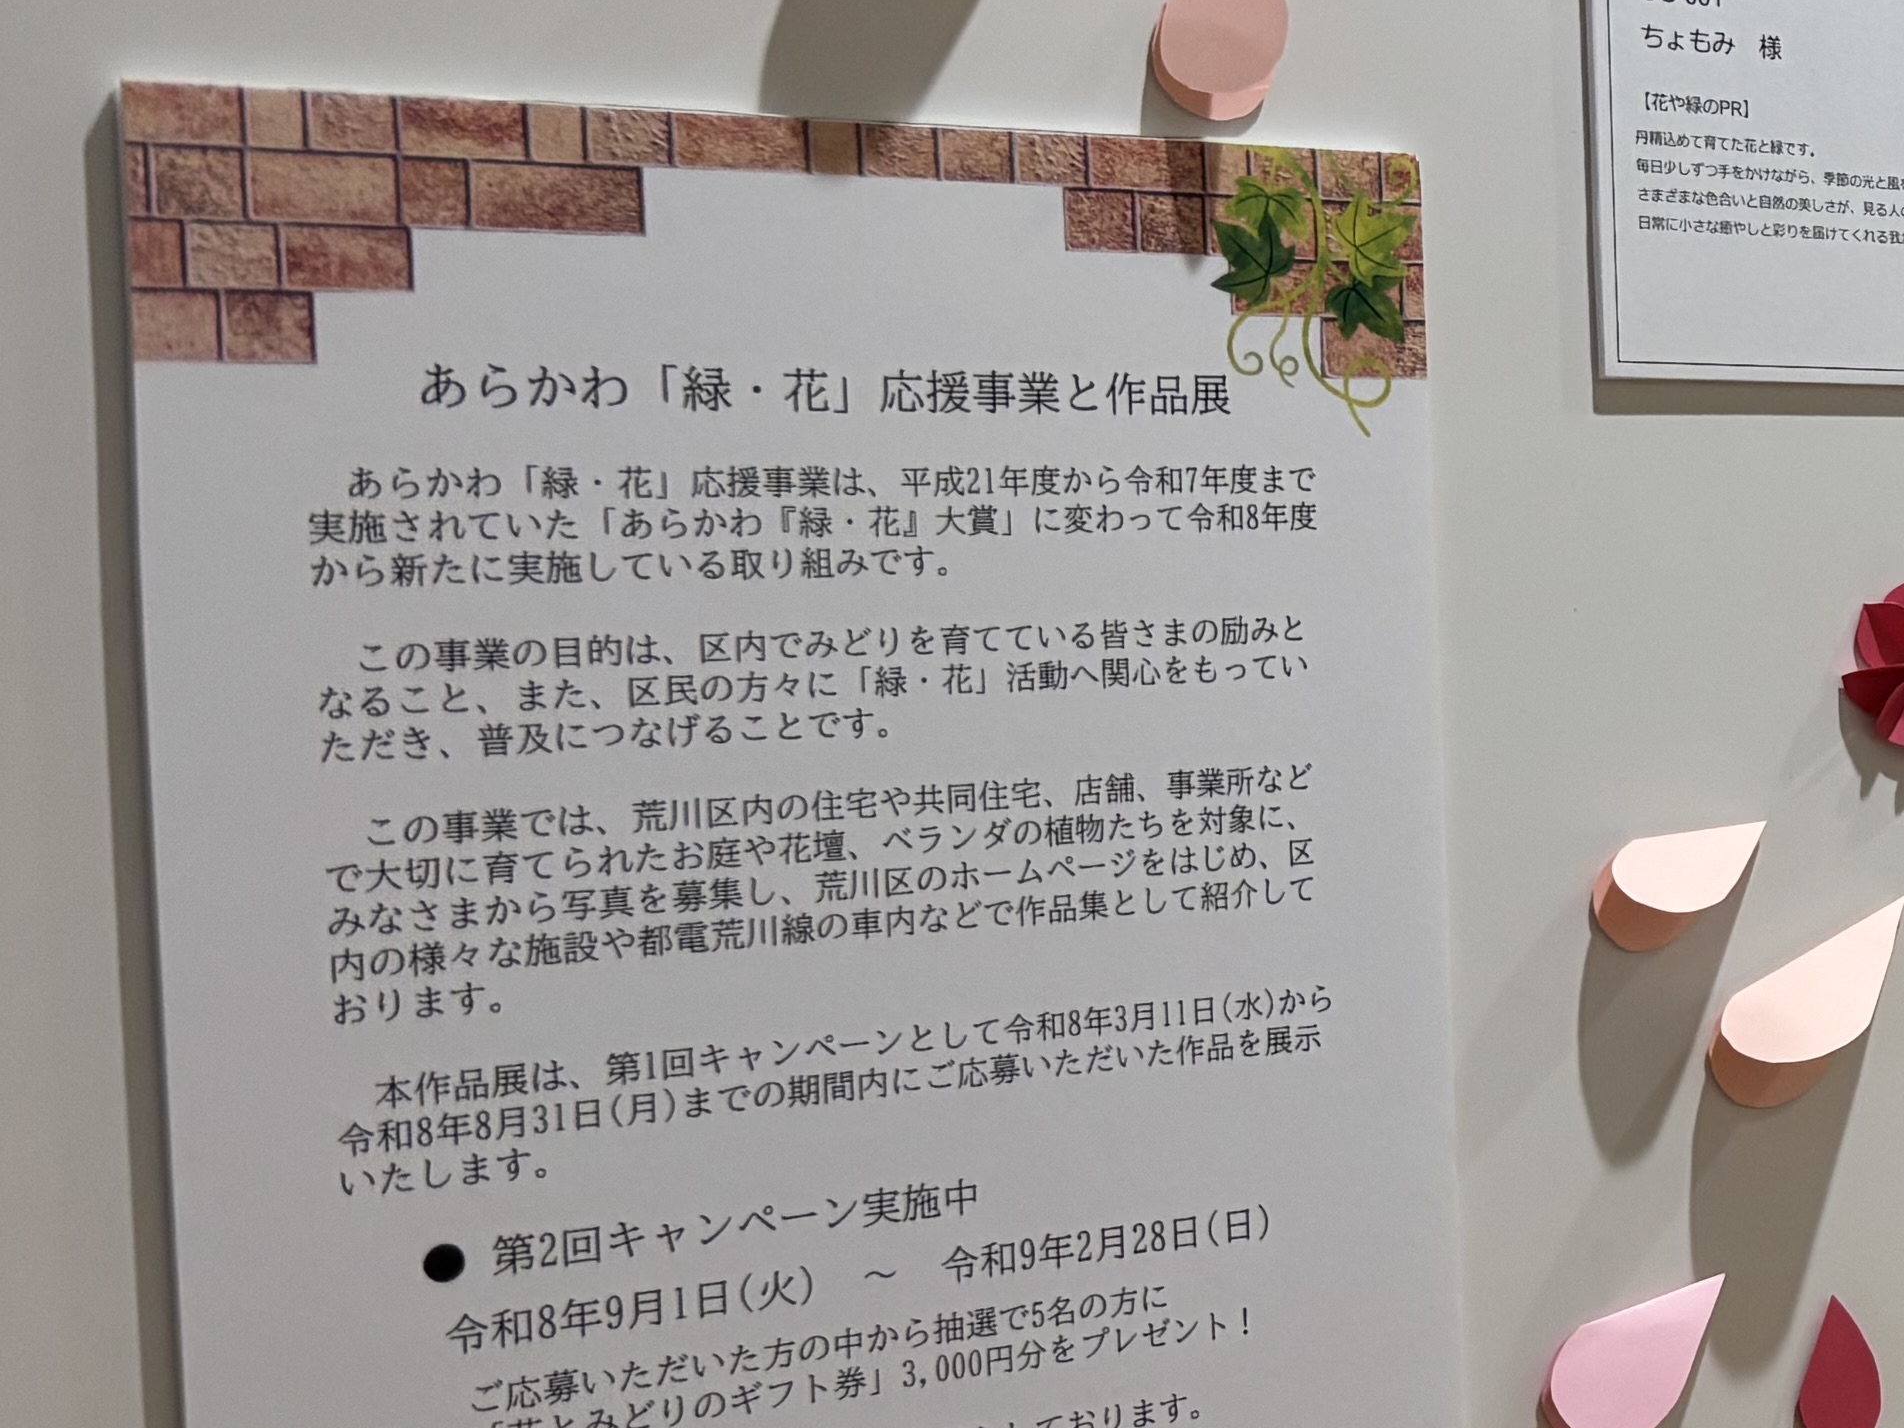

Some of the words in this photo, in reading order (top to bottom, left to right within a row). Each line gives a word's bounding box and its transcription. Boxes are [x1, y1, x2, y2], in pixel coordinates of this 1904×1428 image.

[1641, 24, 1737, 56] ちょもみ
[1759, 34, 1783, 61] 様
[1644, 90, 1750, 120] 【花や緑のPR】
[420, 362, 1232, 416] あらかわ「緑・花」応援事業と作品展
[348, 464, 1317, 500] あらかわ「緑・花」応援事業は、平成21年度から令和7年度まで
[309, 503, 1318, 546] 実施されていた「あらかわ『緑・花』大賞」に変わって令和8年度
[311, 546, 950, 588] から新たに実施している取り組みです。
[359, 614, 1305, 674] この事業の目的は、区内でみどりを育てている皆さまの励みと
[319, 655, 1308, 720] なること、また、区民の方々に「緑・花」活動へ関心をもってい
[320, 707, 889, 763] ただき、普及につなげることです。
[366, 762, 1312, 847] この事業では、荒川区内の住宅や共同住宅、店舗、事業所など
[326, 804, 1299, 894] で大切に育てられたお庭や花壇、ベランダの植物たちを対象に、
[328, 838, 1316, 938] みなさまから写真を募集し、荒川区のホームページをはじめ、区
[331, 875, 1315, 985] 内の様々な施設や都電荒川線の車内などで作品集として紹介して
[333, 983, 502, 1026] おります。
[339, 1146, 549, 1197] いたします。
[492, 1177, 979, 1277] 第2回キャンペーン実施中
[471, 1283, 1169, 1414] ご応募いただいた方の中から抽選で5名の方に
